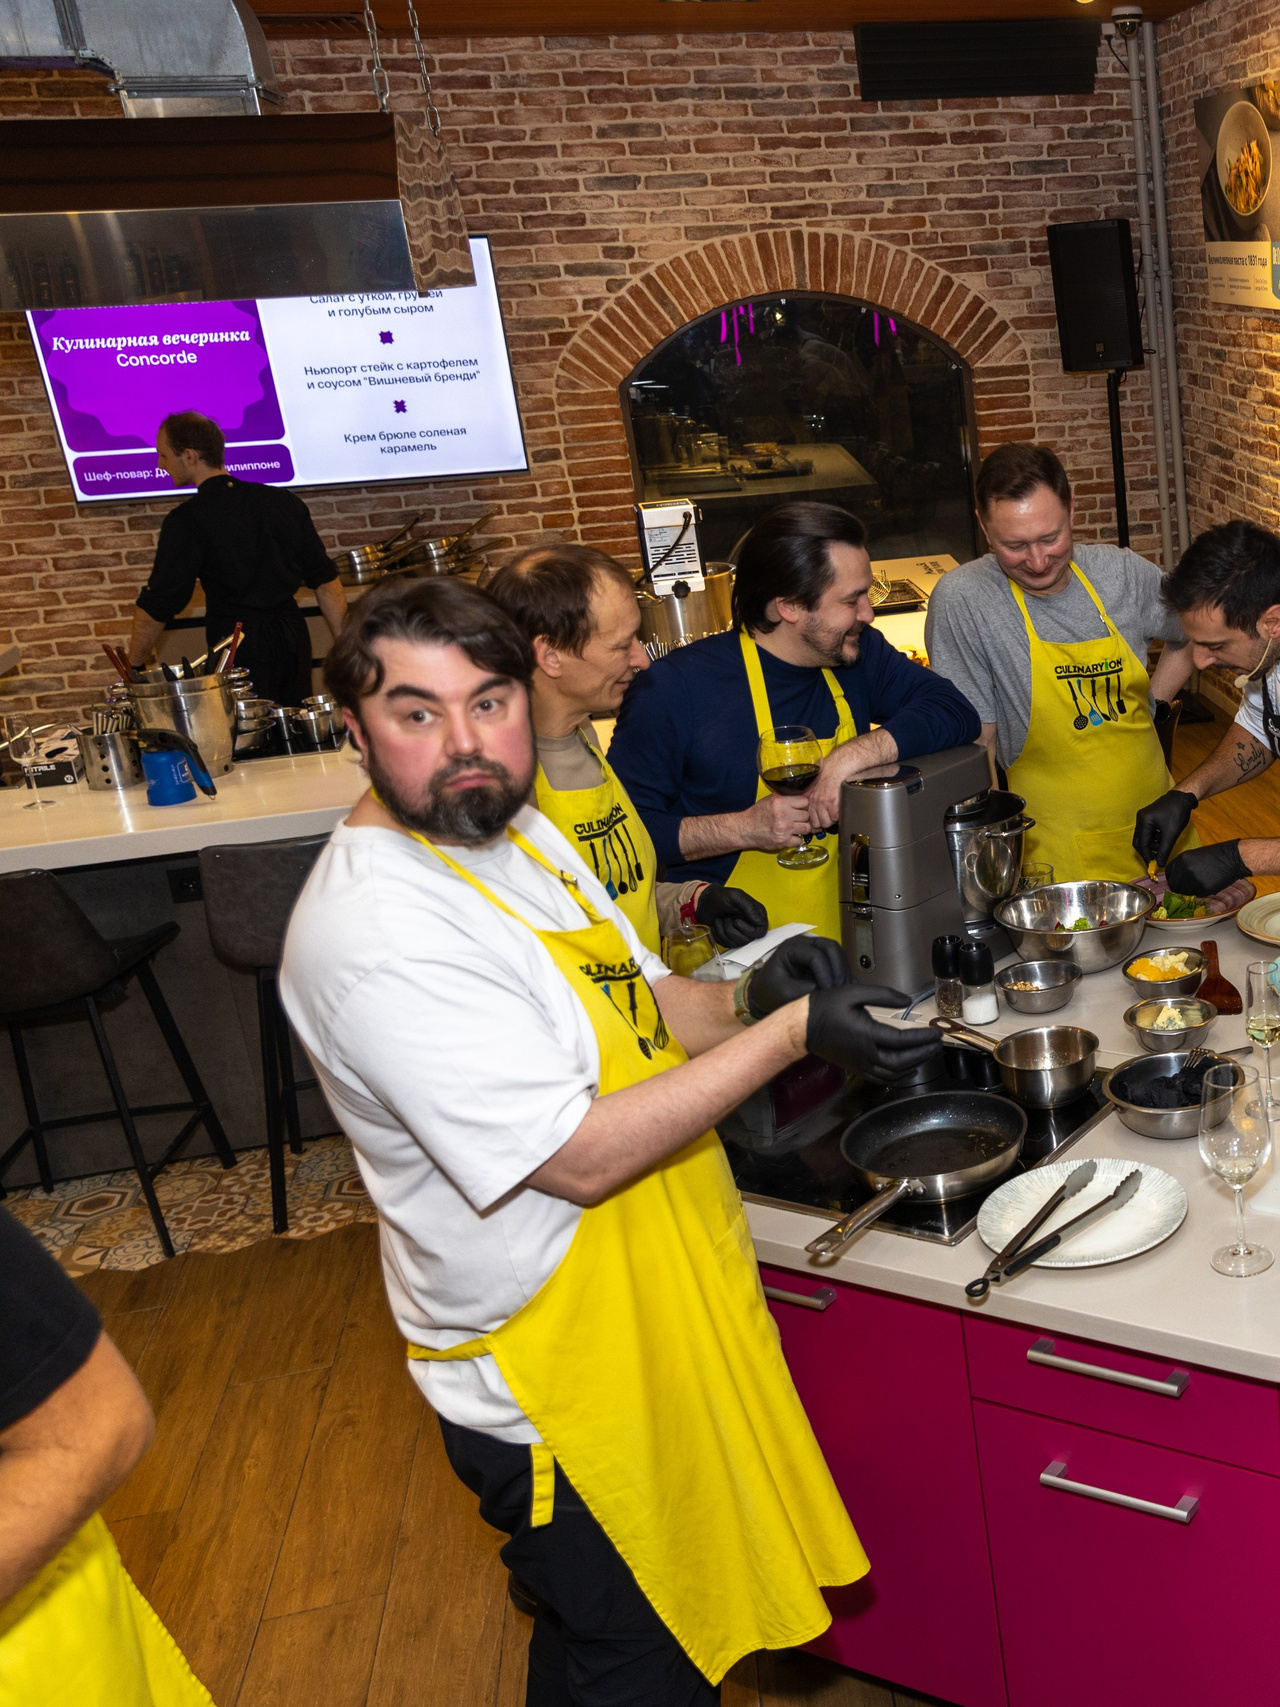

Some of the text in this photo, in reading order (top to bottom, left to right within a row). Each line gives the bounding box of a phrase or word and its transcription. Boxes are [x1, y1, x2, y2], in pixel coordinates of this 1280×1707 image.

[1234, 256, 1244, 266] паста
[1248, 254, 1257, 266] 1831
[1258, 257, 1267, 268] года
[348, 294, 356, 302] с
[398, 289, 443, 302] груей
[327, 304, 434, 318] и голубым сыром
[52, 330, 250, 353] Кулинарная вечеринка
[116, 350, 197, 367] Concorde
[304, 357, 479, 376] Ньюпорт стейк с картофелем
[307, 370, 481, 391] и соусом "Вишневый бренди"
[343, 427, 467, 444] Крем брюле соленая
[380, 442, 437, 455] карамель
[84, 468, 153, 482] Шеф-повар:
[224, 461, 281, 472] илиппоне
